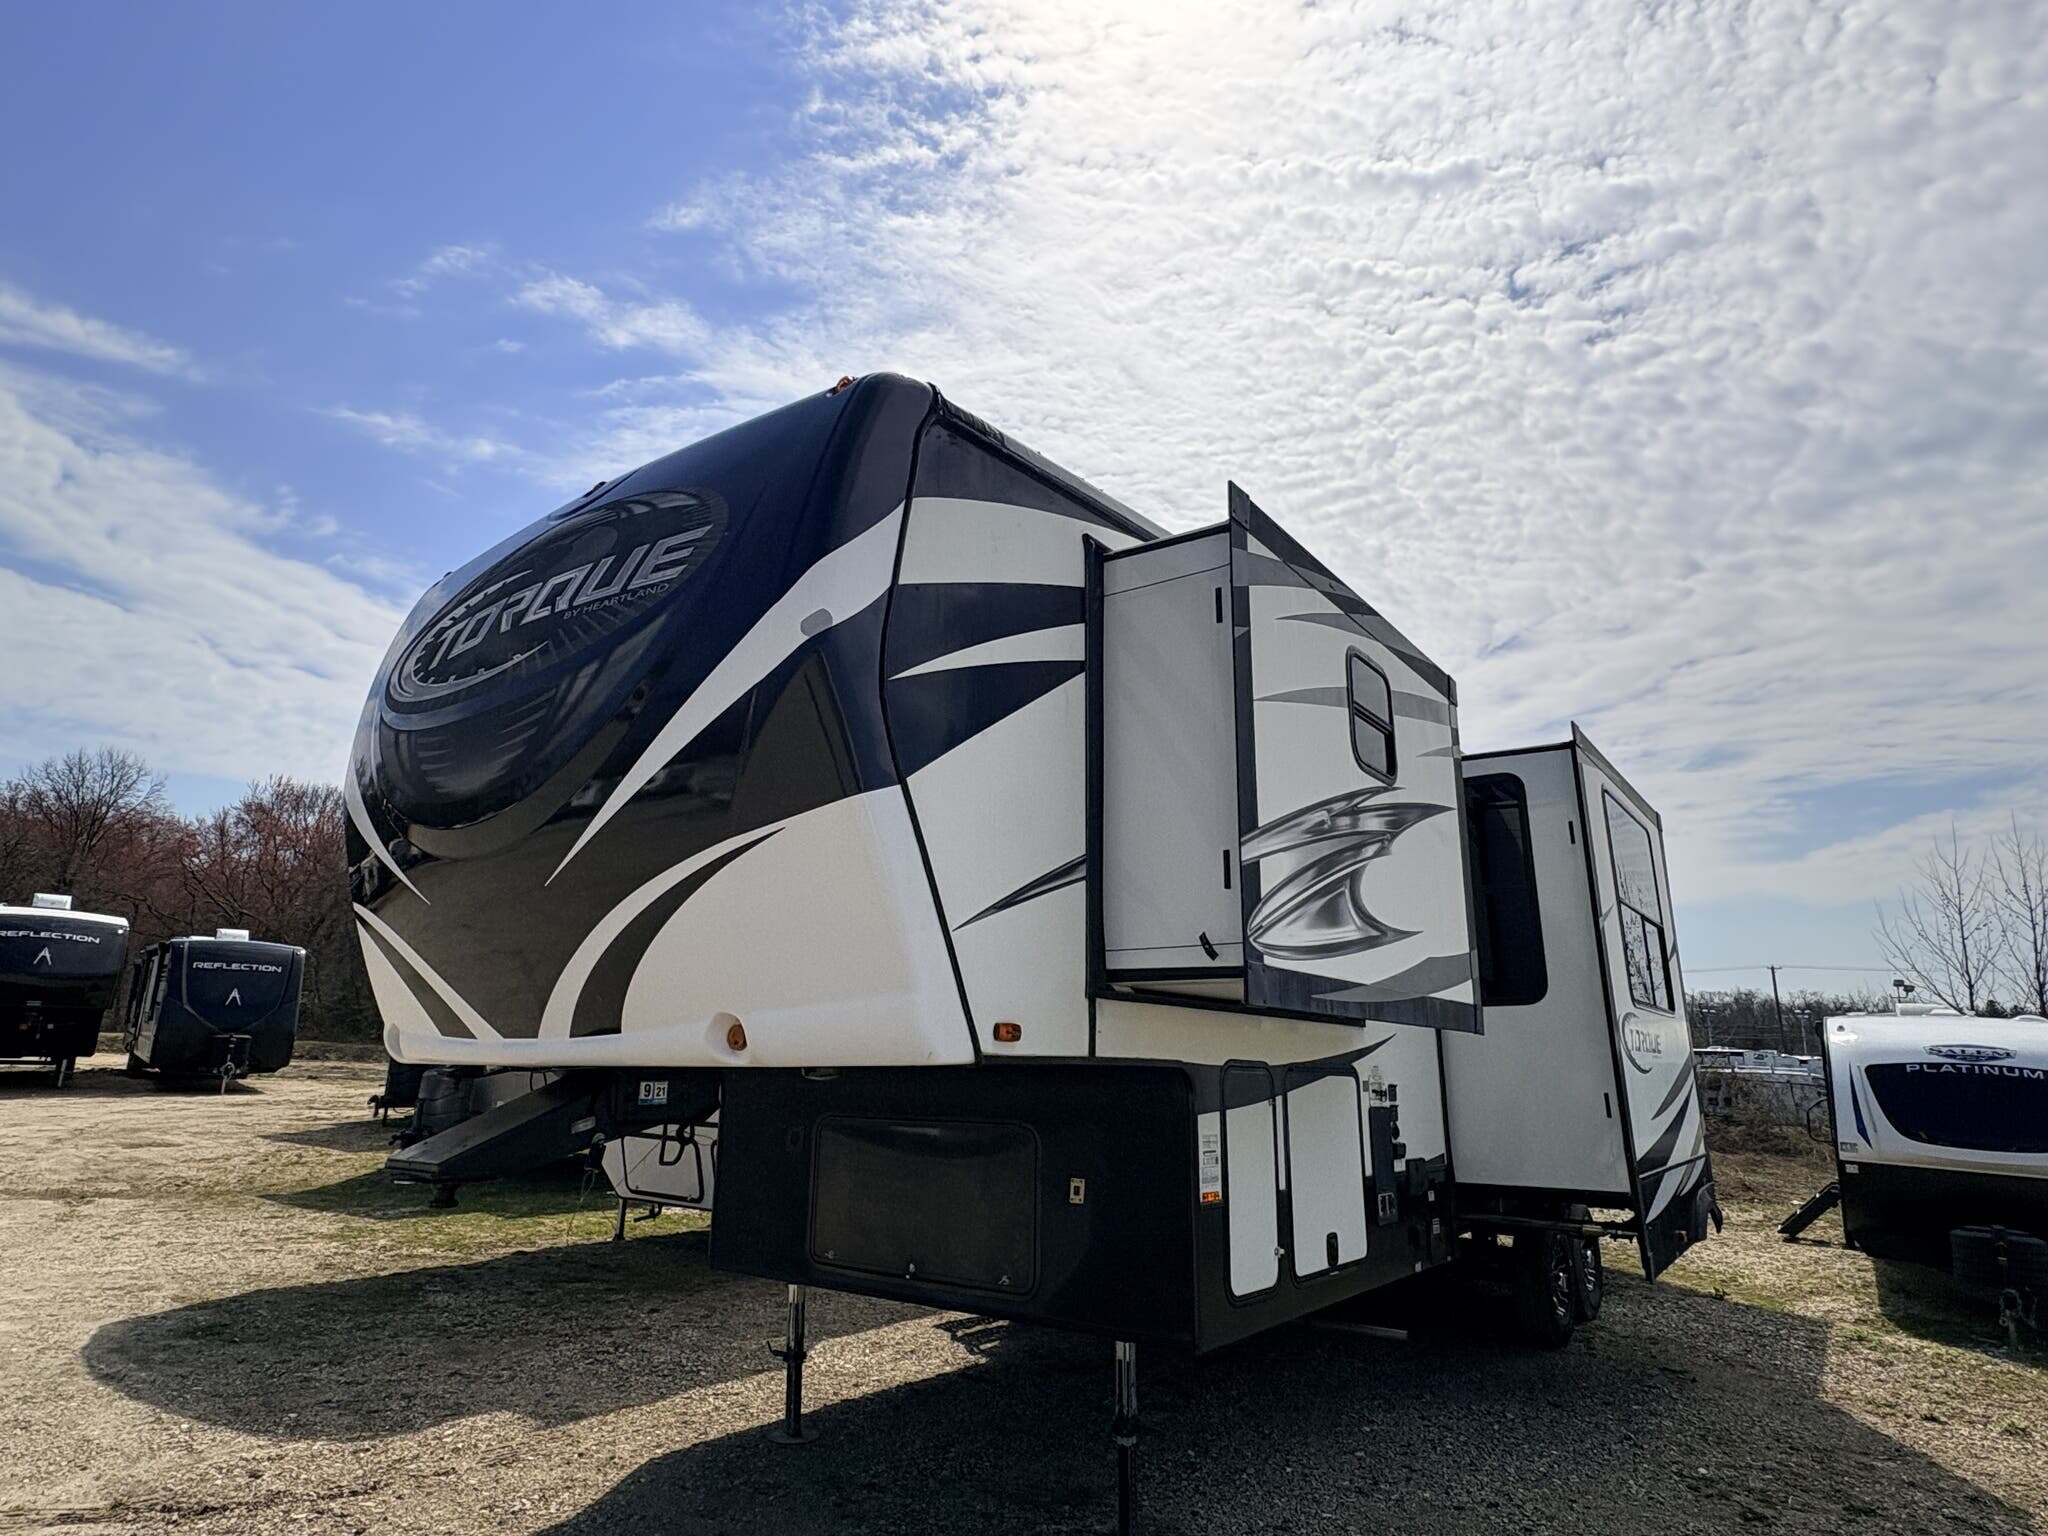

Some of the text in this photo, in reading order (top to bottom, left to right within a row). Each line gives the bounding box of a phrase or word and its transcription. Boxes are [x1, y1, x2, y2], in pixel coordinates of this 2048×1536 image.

[426, 523, 714, 671] TORQUE
[563, 583, 670, 620] BY HEARTLAND
[0, 930, 100, 944] REFLECTION
[192, 961, 283, 973] REFLECTION
[1629, 1028, 1662, 1054] TORQUE
[1906, 1063, 2044, 1079] PLATINUM
[644, 1083, 652, 1098] 9
